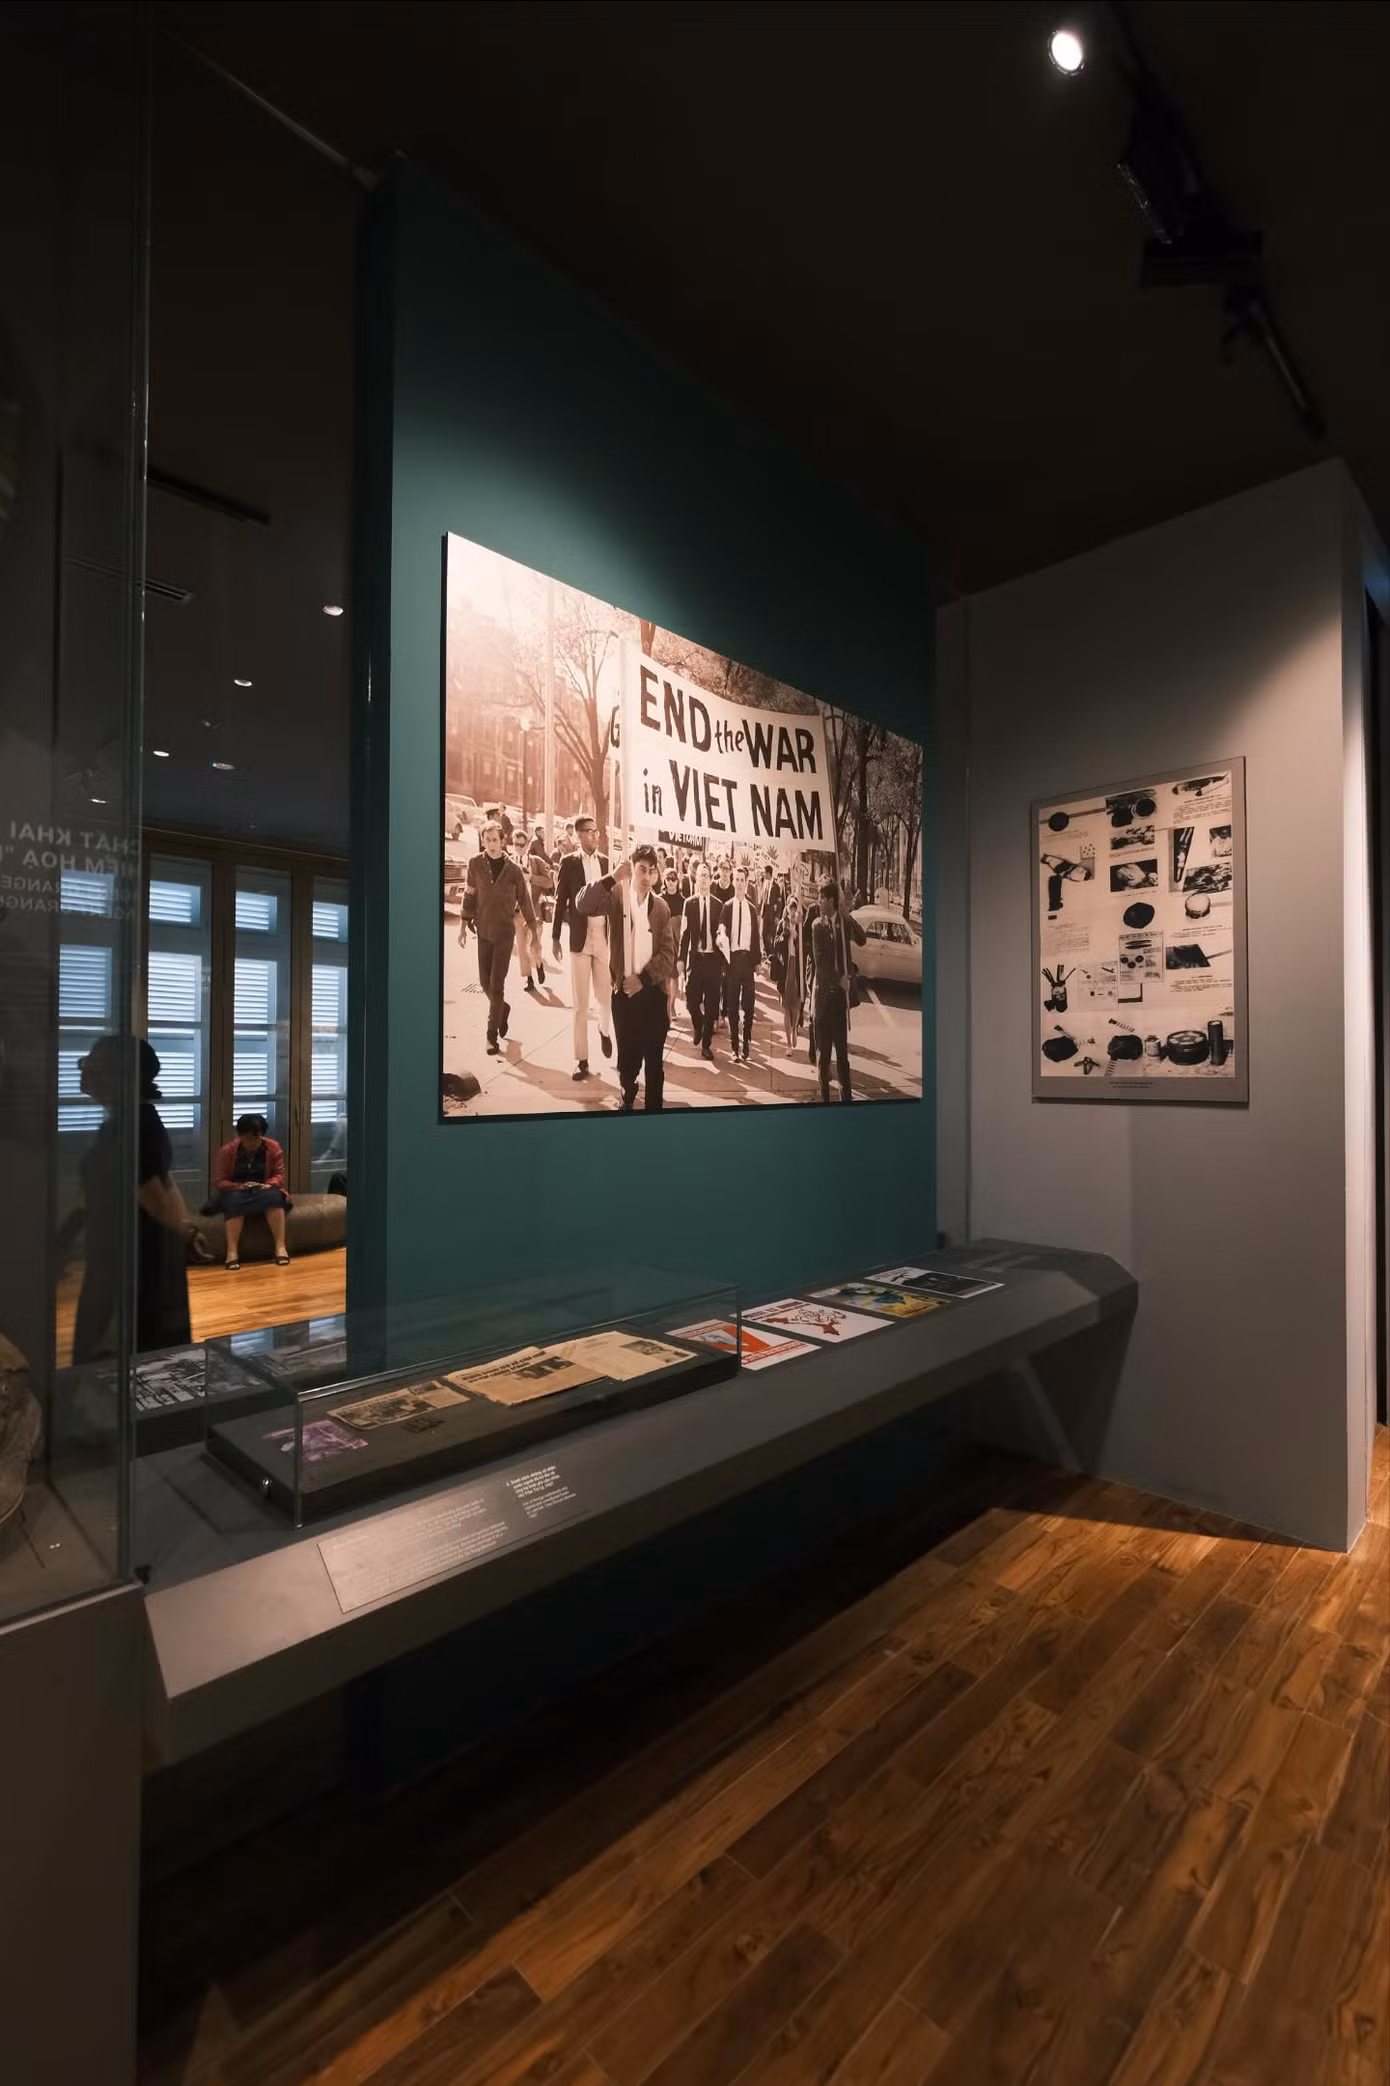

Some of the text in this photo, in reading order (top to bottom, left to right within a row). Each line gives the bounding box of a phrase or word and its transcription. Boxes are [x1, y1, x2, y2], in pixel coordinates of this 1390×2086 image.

[640, 664, 817, 774] END the WAR
[643, 759, 824, 841] in VIET NAM
